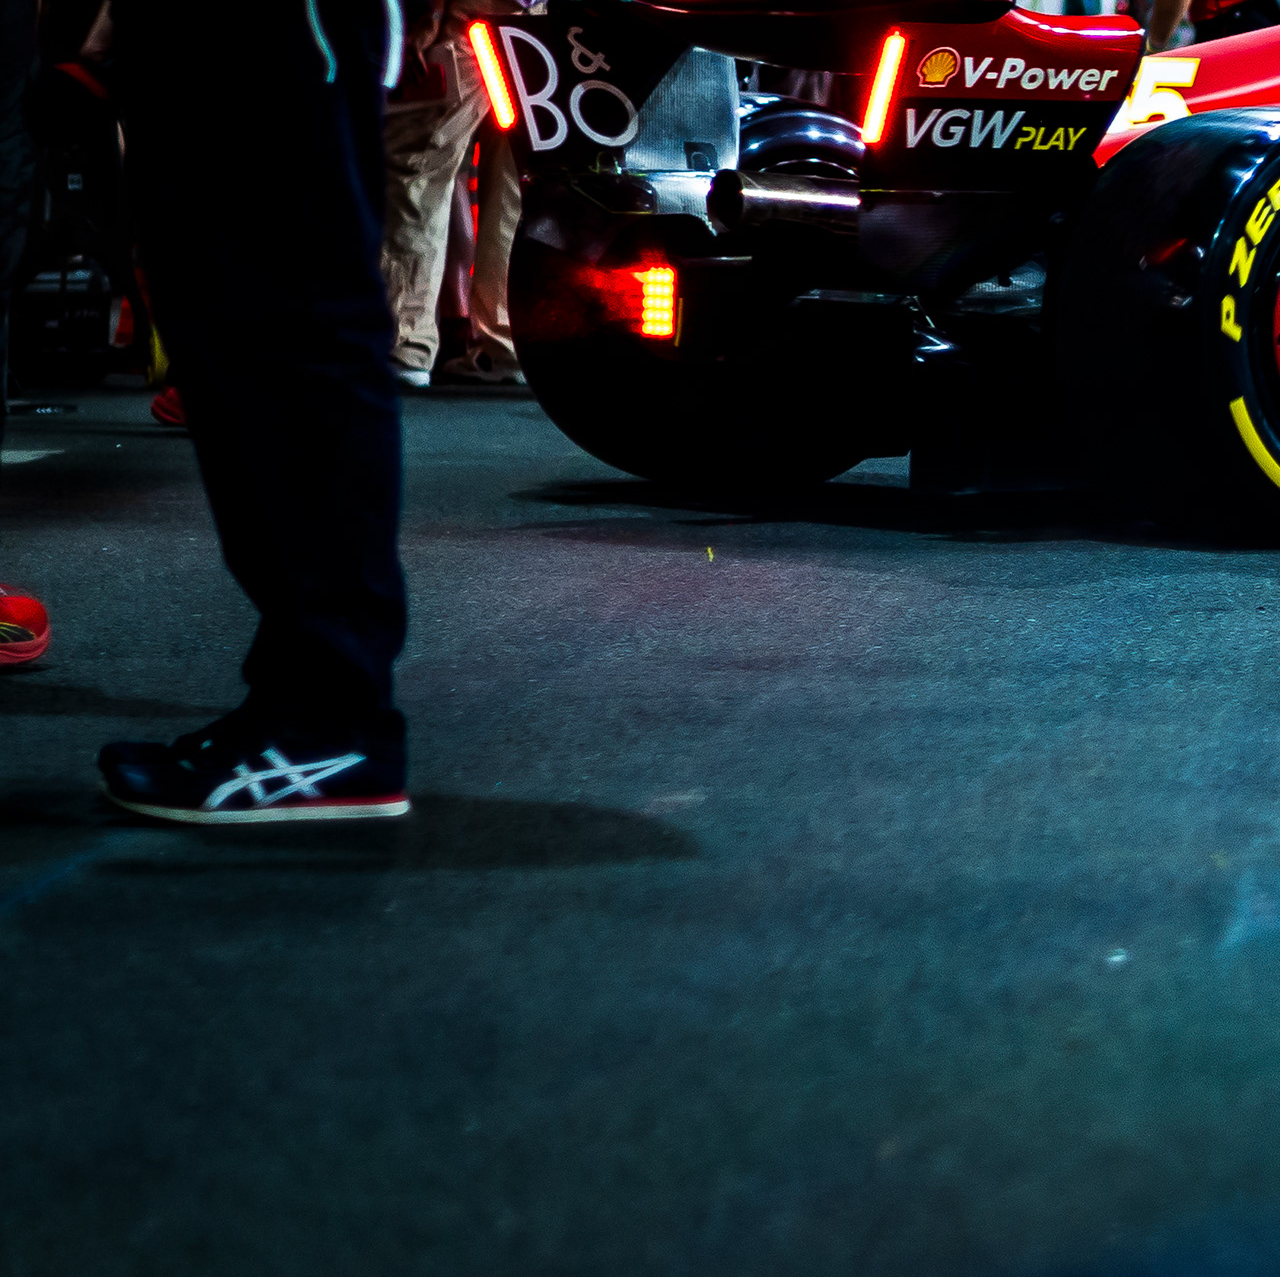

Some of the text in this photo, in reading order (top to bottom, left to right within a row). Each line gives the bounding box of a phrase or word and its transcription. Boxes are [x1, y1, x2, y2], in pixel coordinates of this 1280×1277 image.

[963, 56, 1119, 92] V-Power
[905, 108, 1087, 151] VGW PLAY
